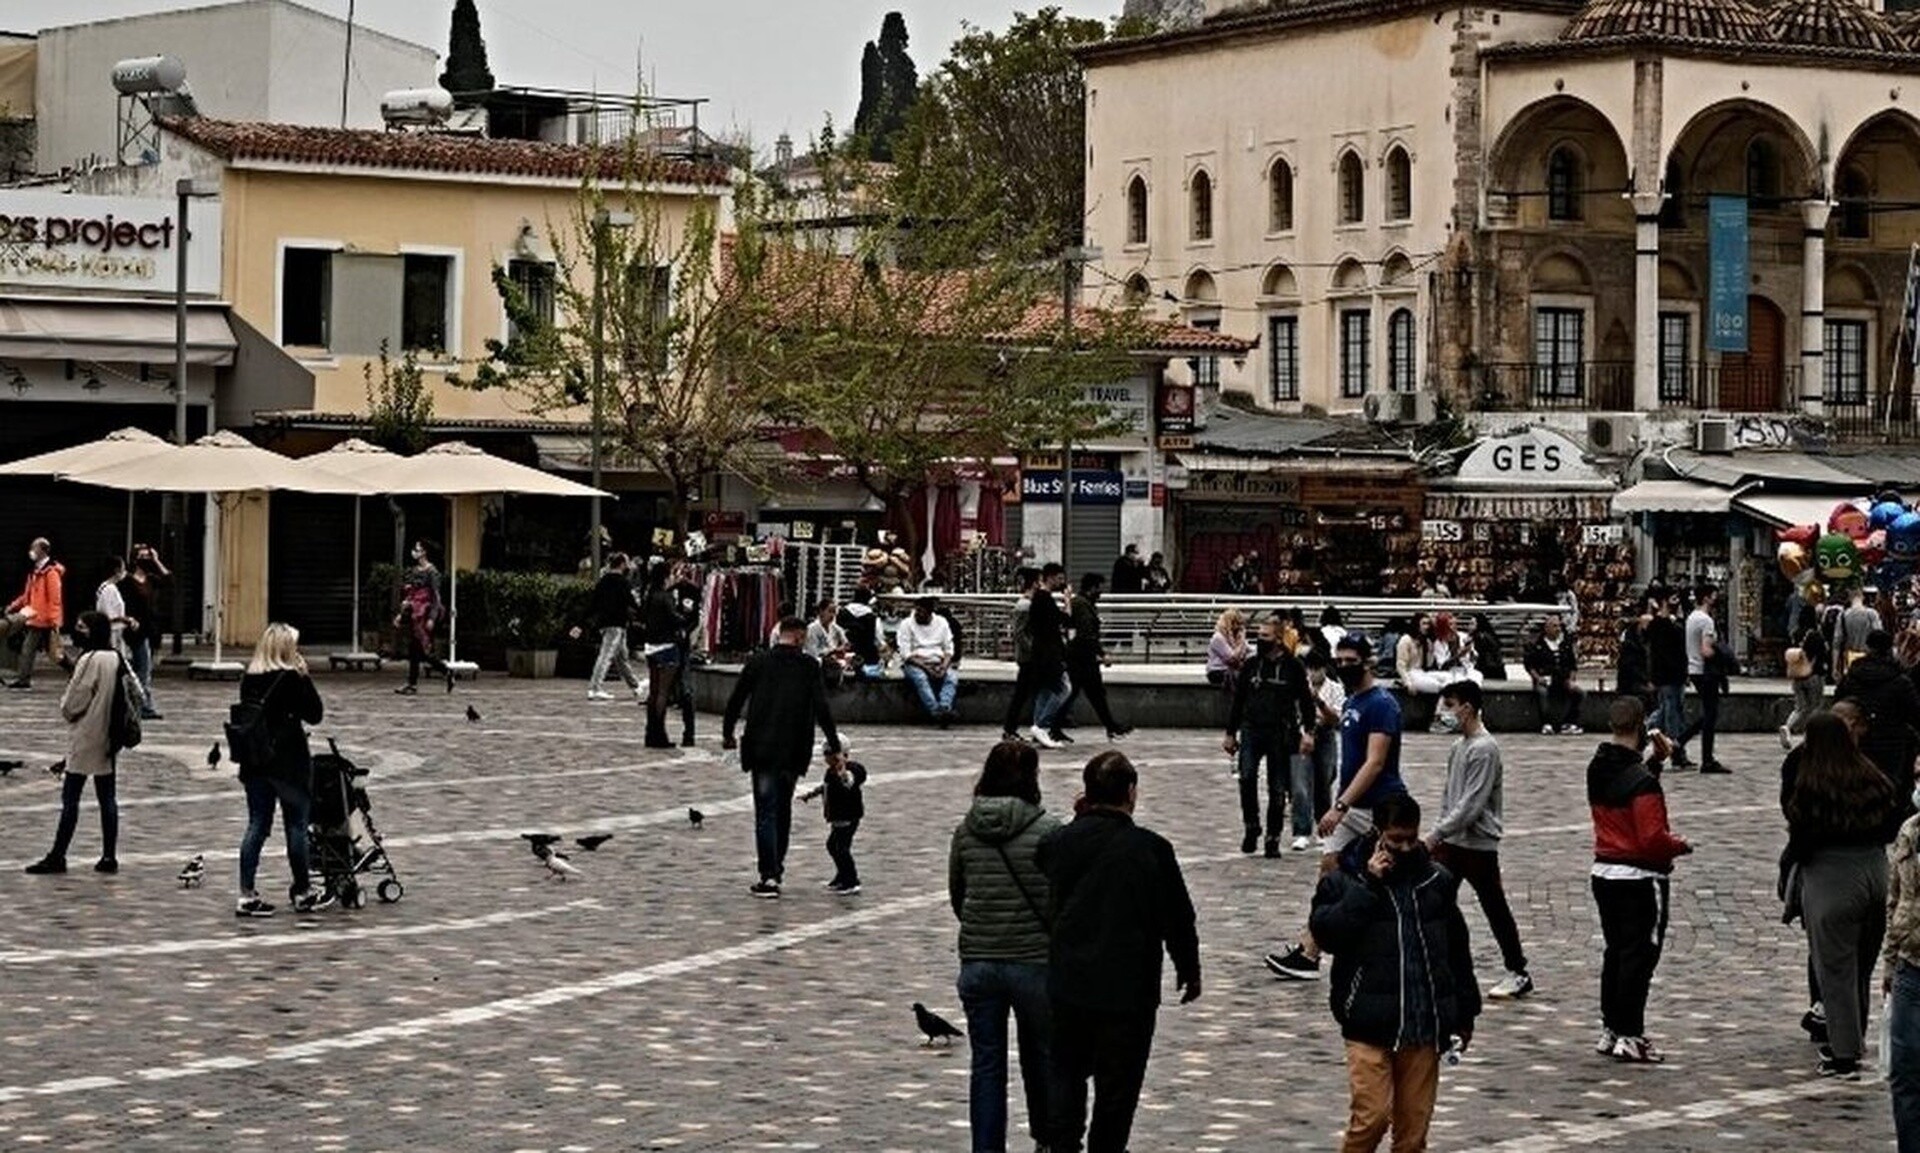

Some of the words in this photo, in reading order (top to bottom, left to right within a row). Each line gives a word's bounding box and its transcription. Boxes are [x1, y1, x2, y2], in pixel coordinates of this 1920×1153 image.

[46, 214, 174, 251] project
[1089, 387, 1131, 401] TRAVEL
[1163, 438, 1190, 446] ATM
[1493, 445, 1560, 471] GES
[1023, 478, 1050, 494] Blue
[1080, 480, 1121, 496] Ferries
